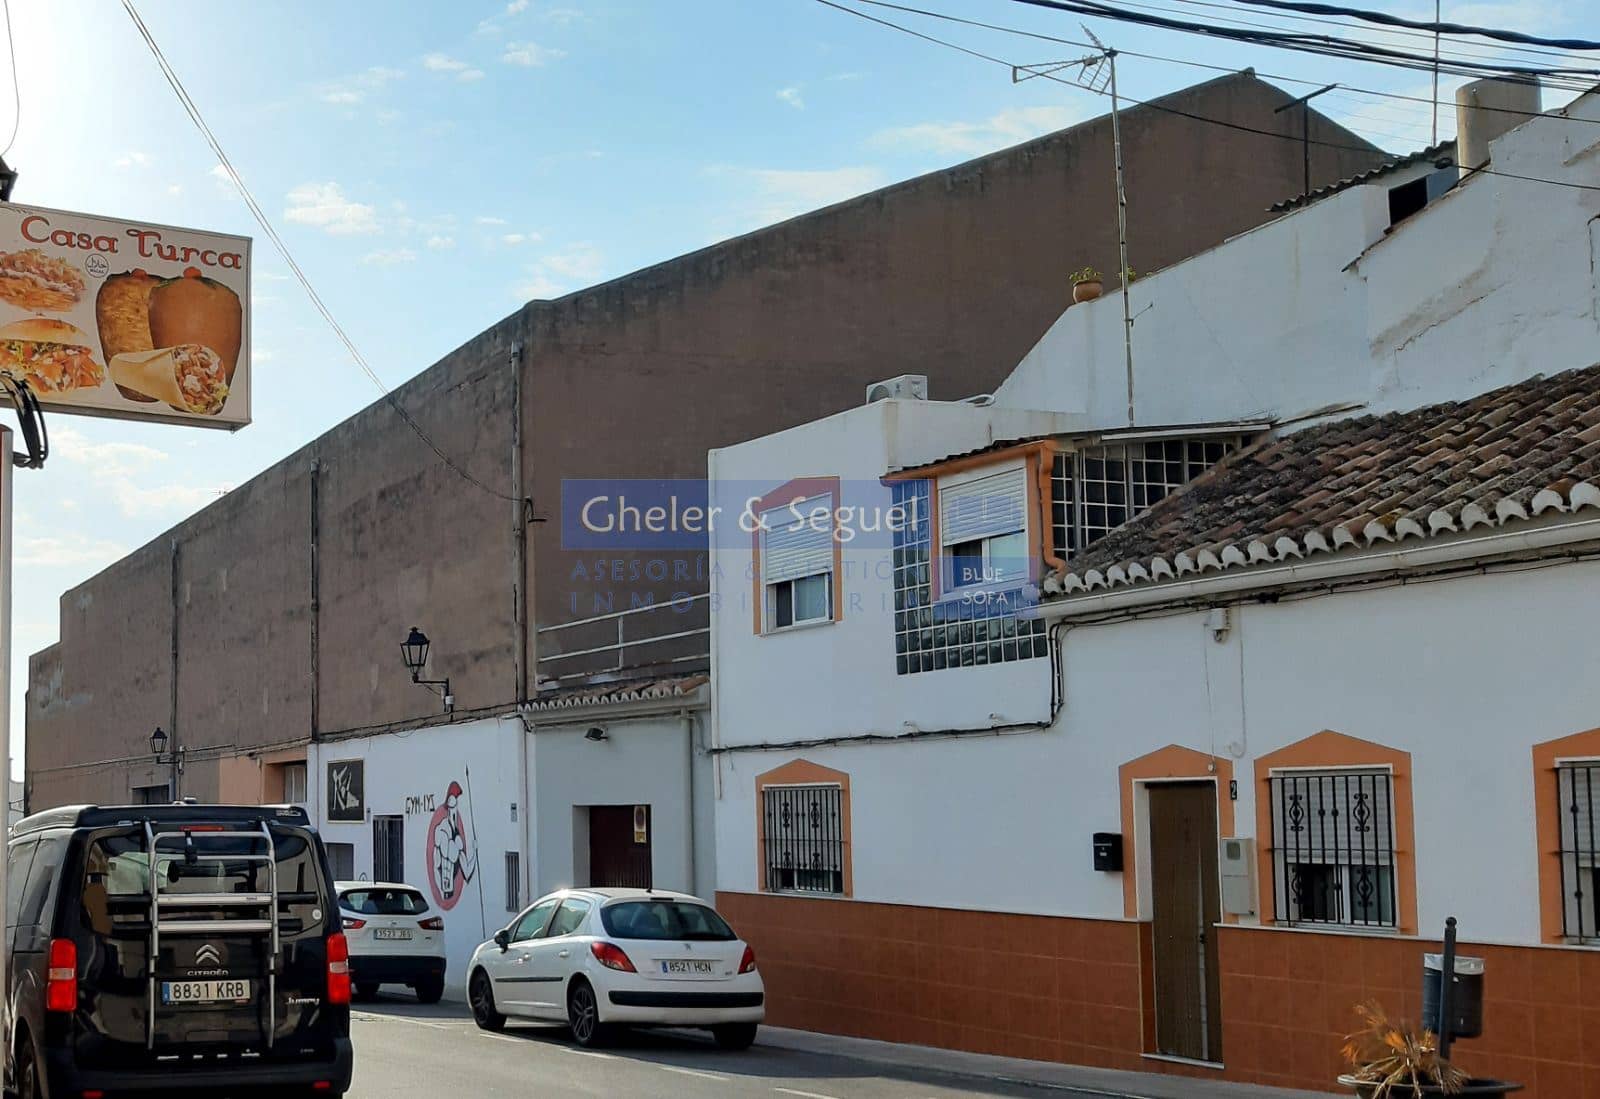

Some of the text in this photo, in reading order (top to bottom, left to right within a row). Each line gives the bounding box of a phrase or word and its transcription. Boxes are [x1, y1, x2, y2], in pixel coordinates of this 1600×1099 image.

[21, 215, 242, 269] Casa Turca
[669, 961, 712, 972] 8521 HCN
[173, 982, 245, 999] 8831 KRB
